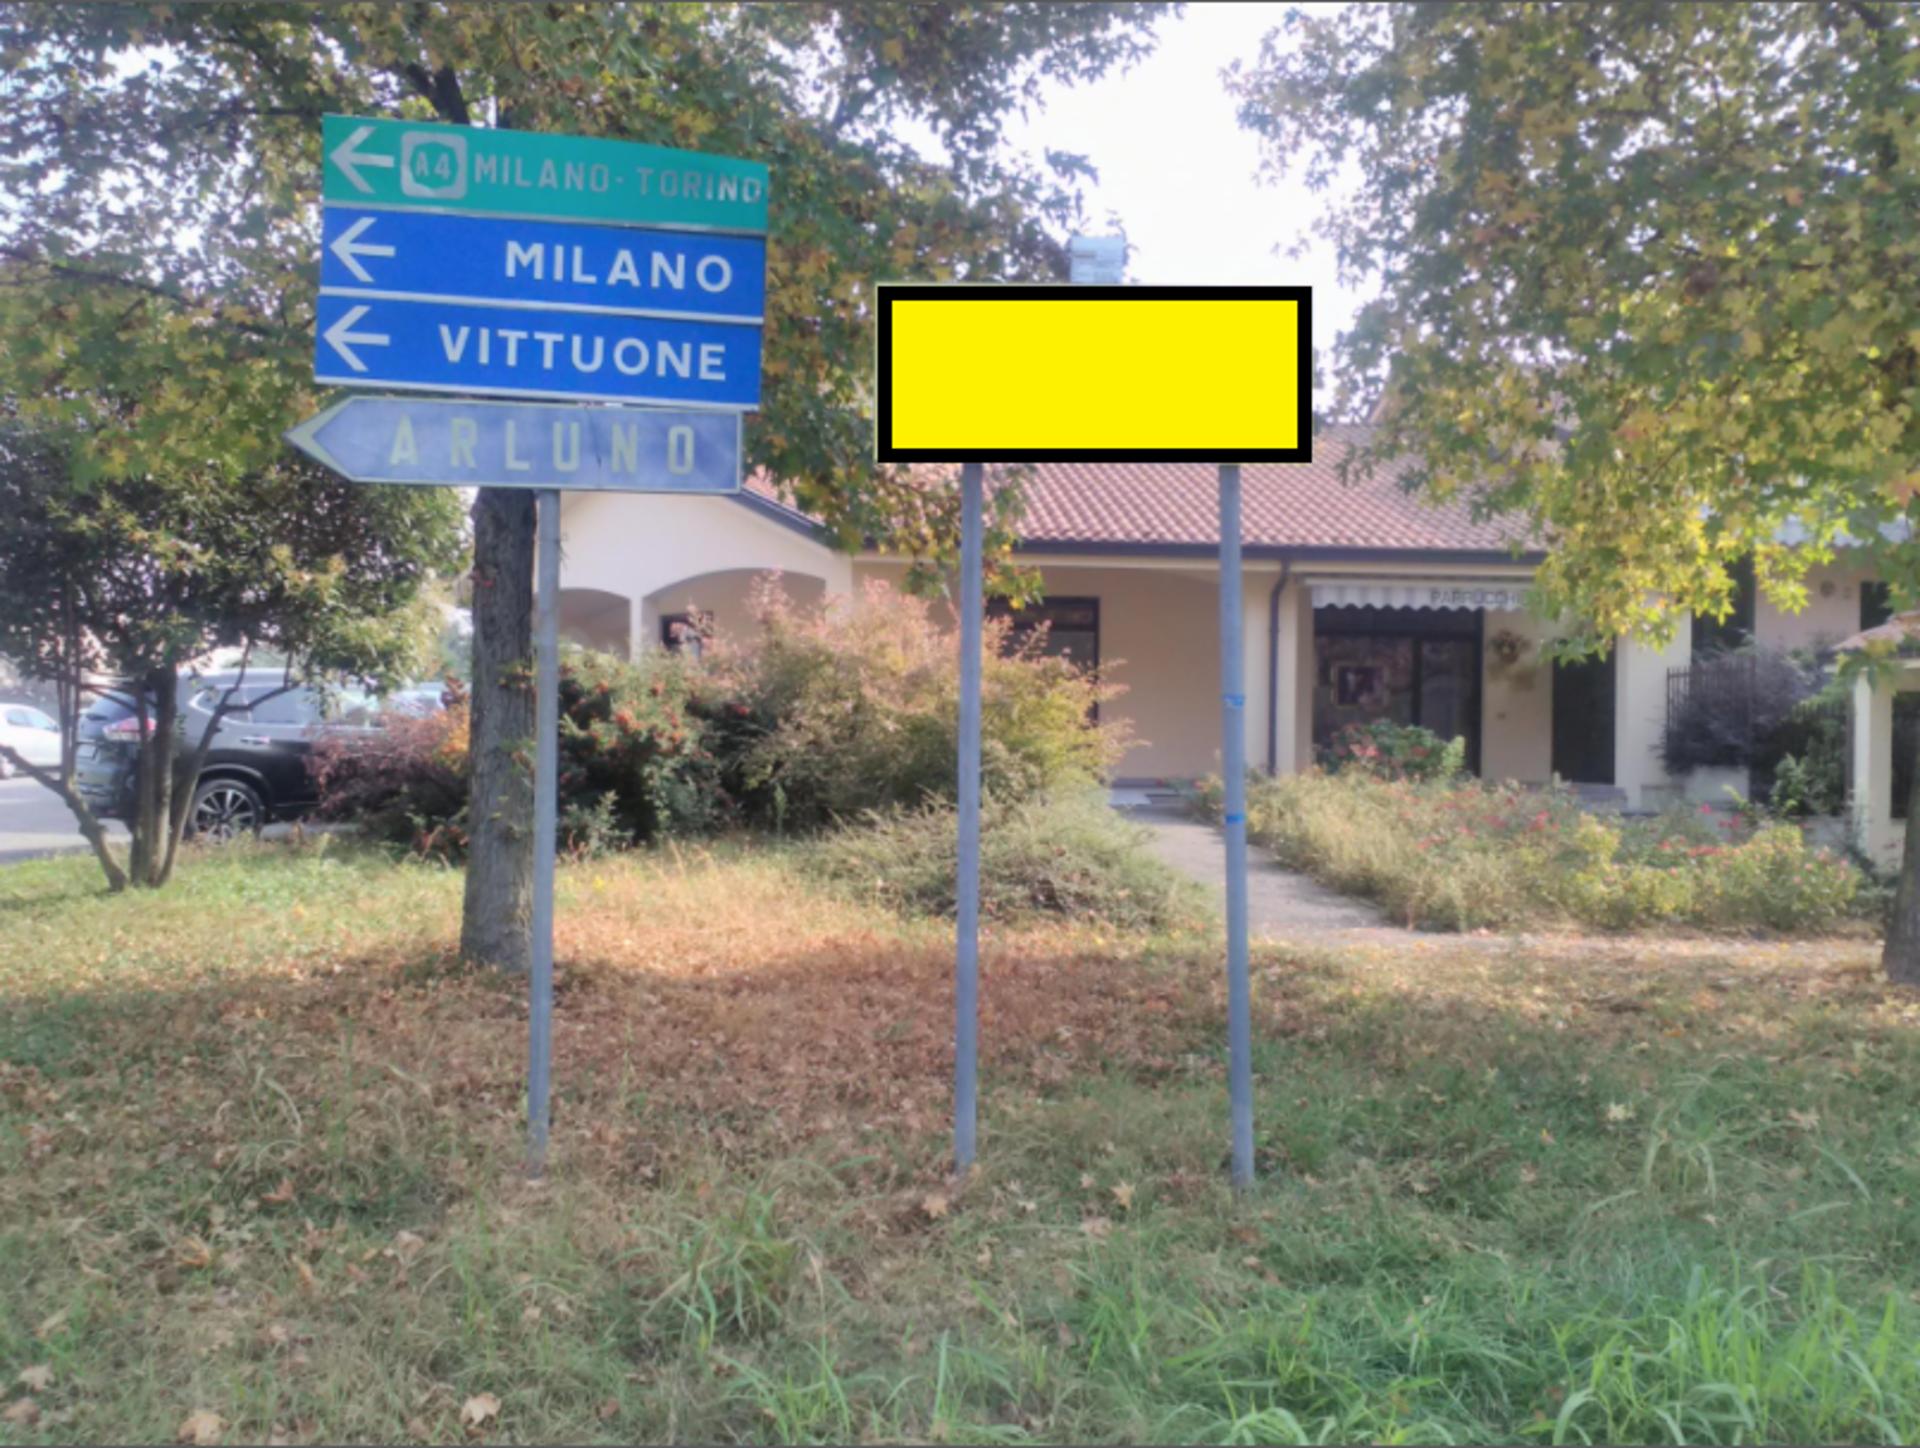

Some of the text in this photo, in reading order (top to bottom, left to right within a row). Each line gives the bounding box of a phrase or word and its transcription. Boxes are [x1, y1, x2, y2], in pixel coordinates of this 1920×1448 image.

[415, 151, 450, 180] A4
[505, 240, 733, 293] MILANO
[438, 324, 726, 382] VITTUONE
[389, 413, 695, 475] ARLUNO
